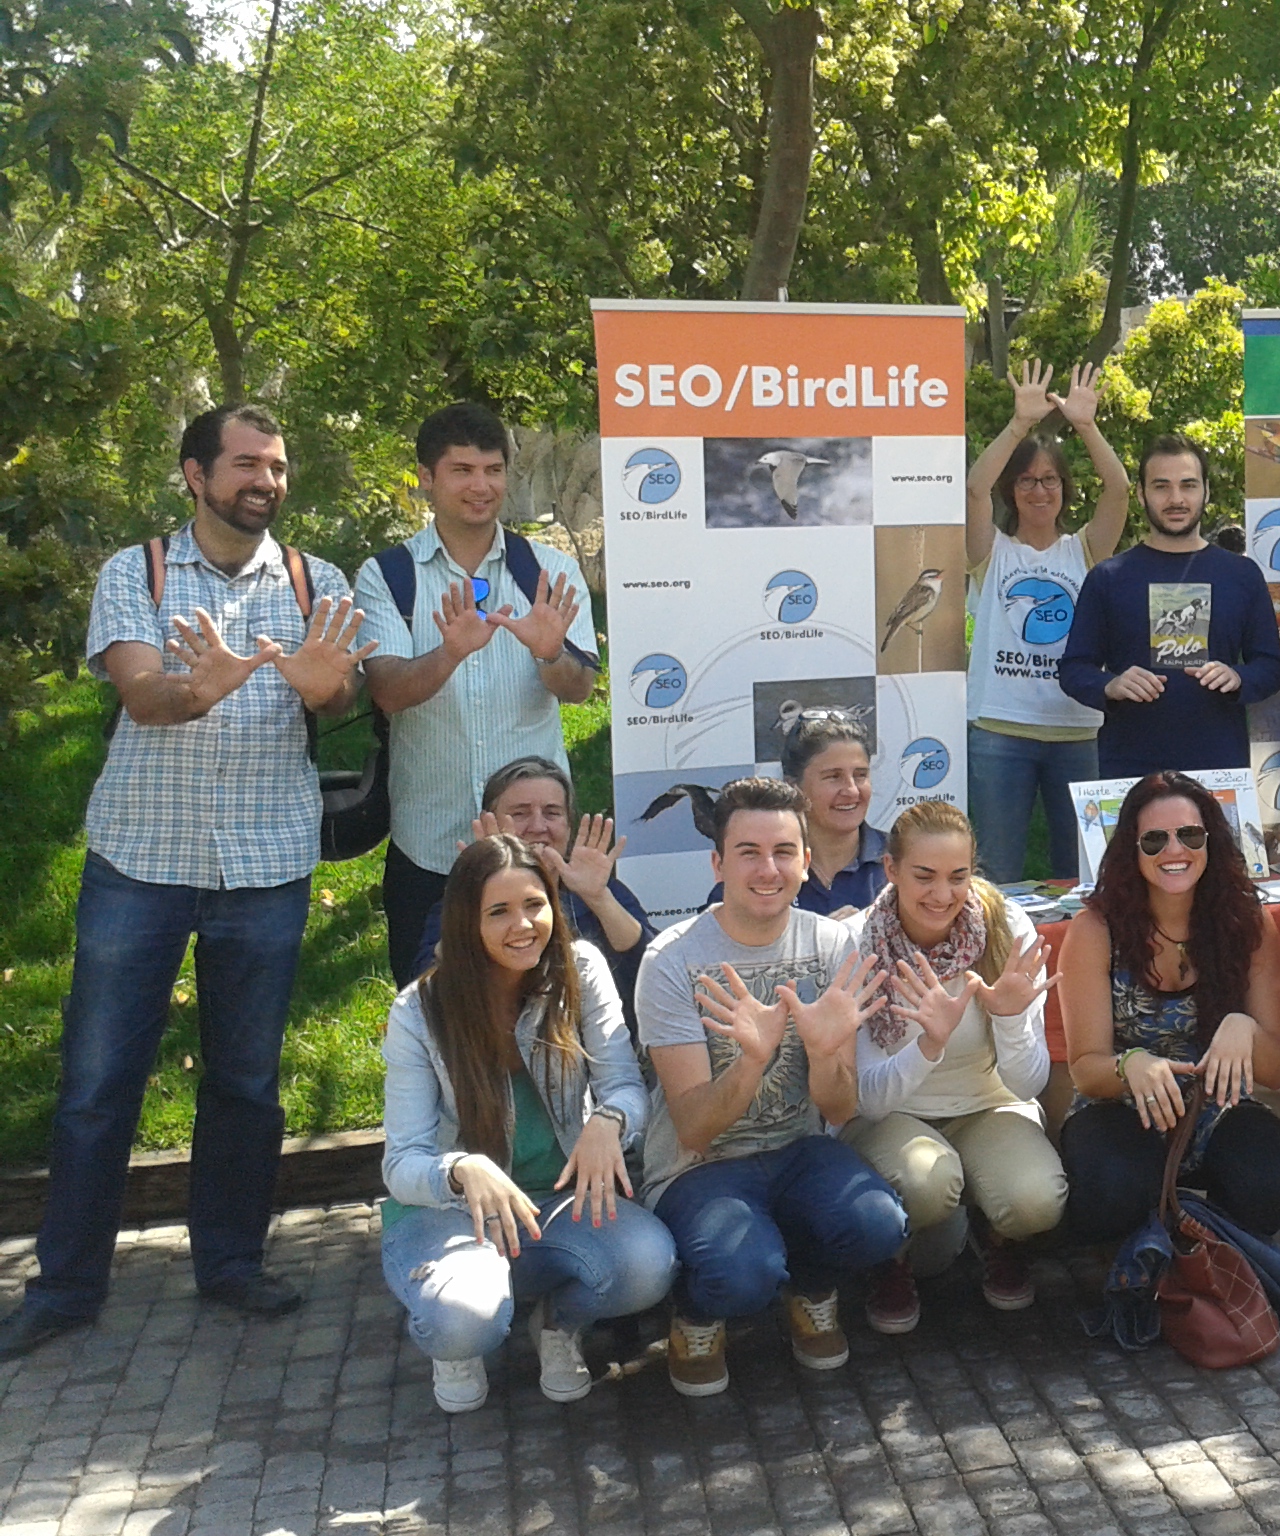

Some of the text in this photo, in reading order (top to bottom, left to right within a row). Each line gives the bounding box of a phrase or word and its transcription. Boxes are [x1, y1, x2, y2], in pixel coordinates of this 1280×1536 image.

[615, 364, 948, 411] SEO/BirdLife
[648, 473, 676, 485] SEO
[891, 473, 953, 484] www.seo.org
[619, 510, 688, 521] SEO/BirdLife
[622, 579, 692, 590] www.seo.org
[788, 594, 813, 605] SEO
[1034, 608, 1068, 623] SEO
[760, 629, 824, 641] SEO/BirdLife
[1156, 636, 1203, 663] Polo
[655, 678, 682, 690] SEO
[626, 713, 694, 726] SEO/BirdLife
[922, 760, 945, 771] SEO
